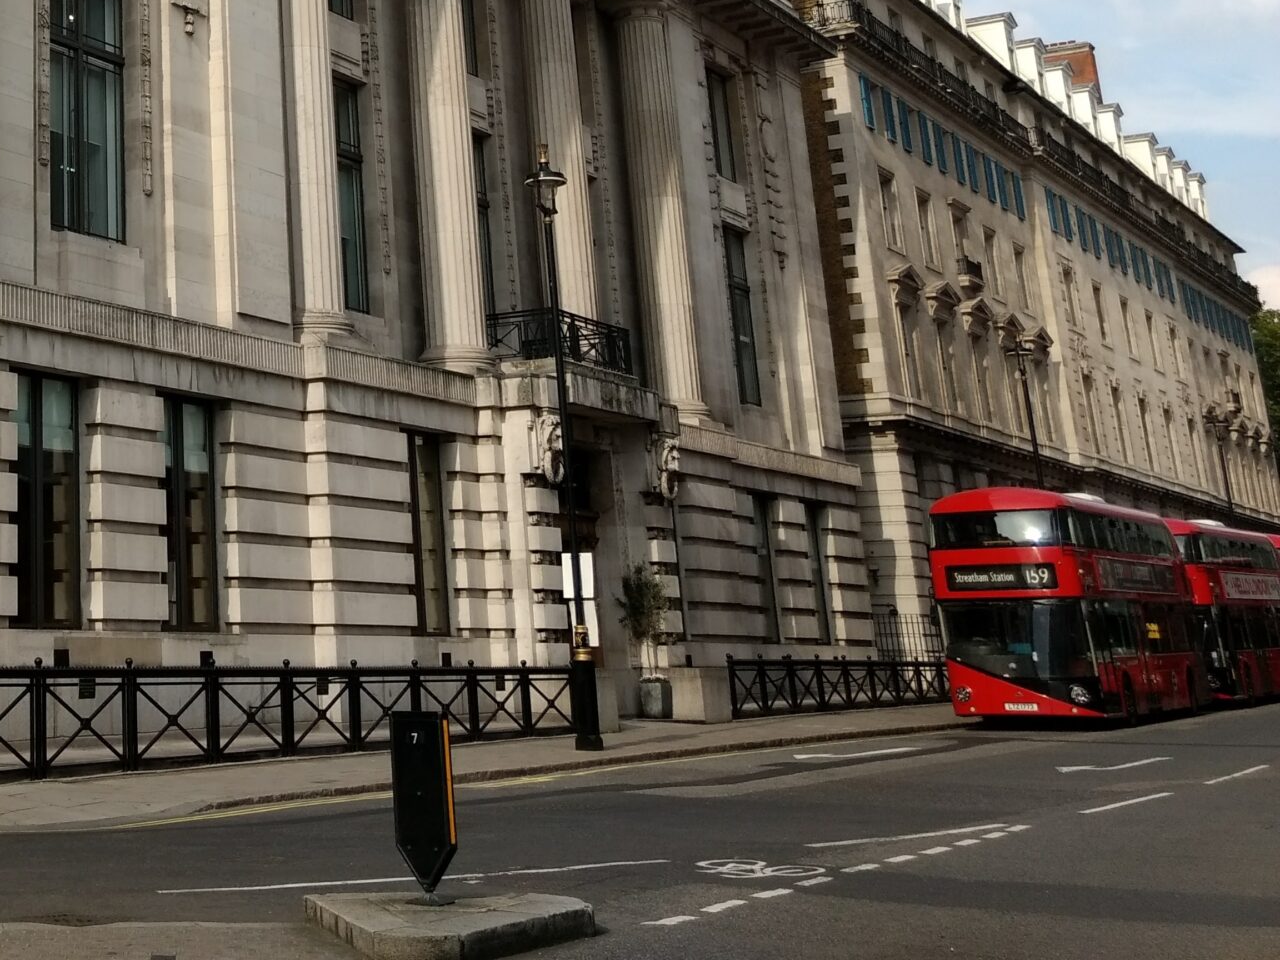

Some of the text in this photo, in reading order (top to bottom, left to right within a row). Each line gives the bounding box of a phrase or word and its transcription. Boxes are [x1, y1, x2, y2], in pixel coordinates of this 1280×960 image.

[953, 567, 1049, 584] Streatham Station 159
[410, 732, 418, 745] 7
